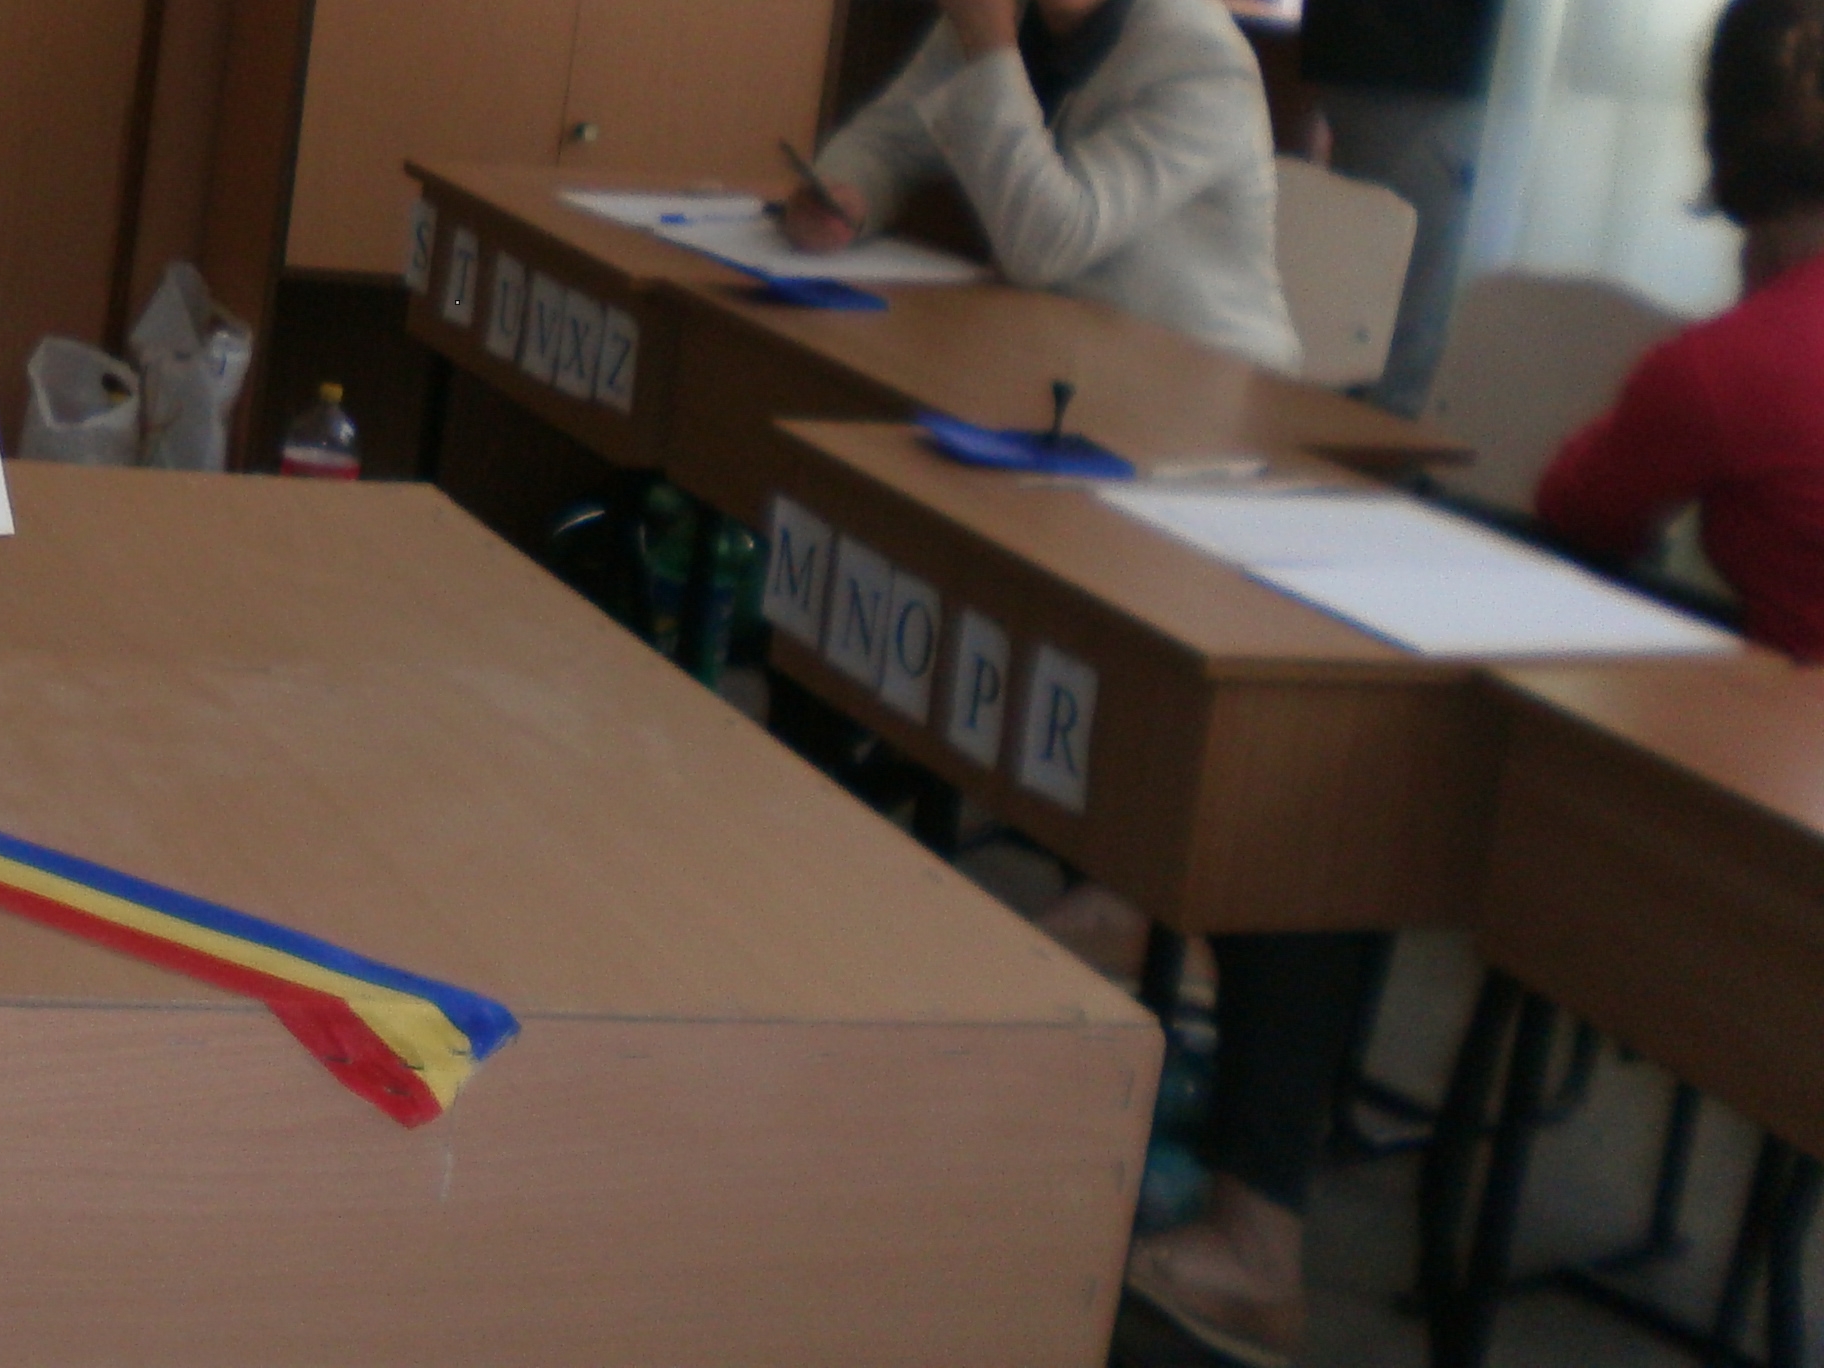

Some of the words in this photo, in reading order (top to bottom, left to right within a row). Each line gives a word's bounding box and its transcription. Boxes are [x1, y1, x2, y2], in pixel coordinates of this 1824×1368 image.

[458, 250, 475, 300] T
[563, 317, 591, 379] X
[774, 526, 817, 612] M
[842, 577, 882, 658] N
[895, 598, 933, 678] O
[967, 653, 1002, 728] P
[1040, 684, 1078, 775] R
